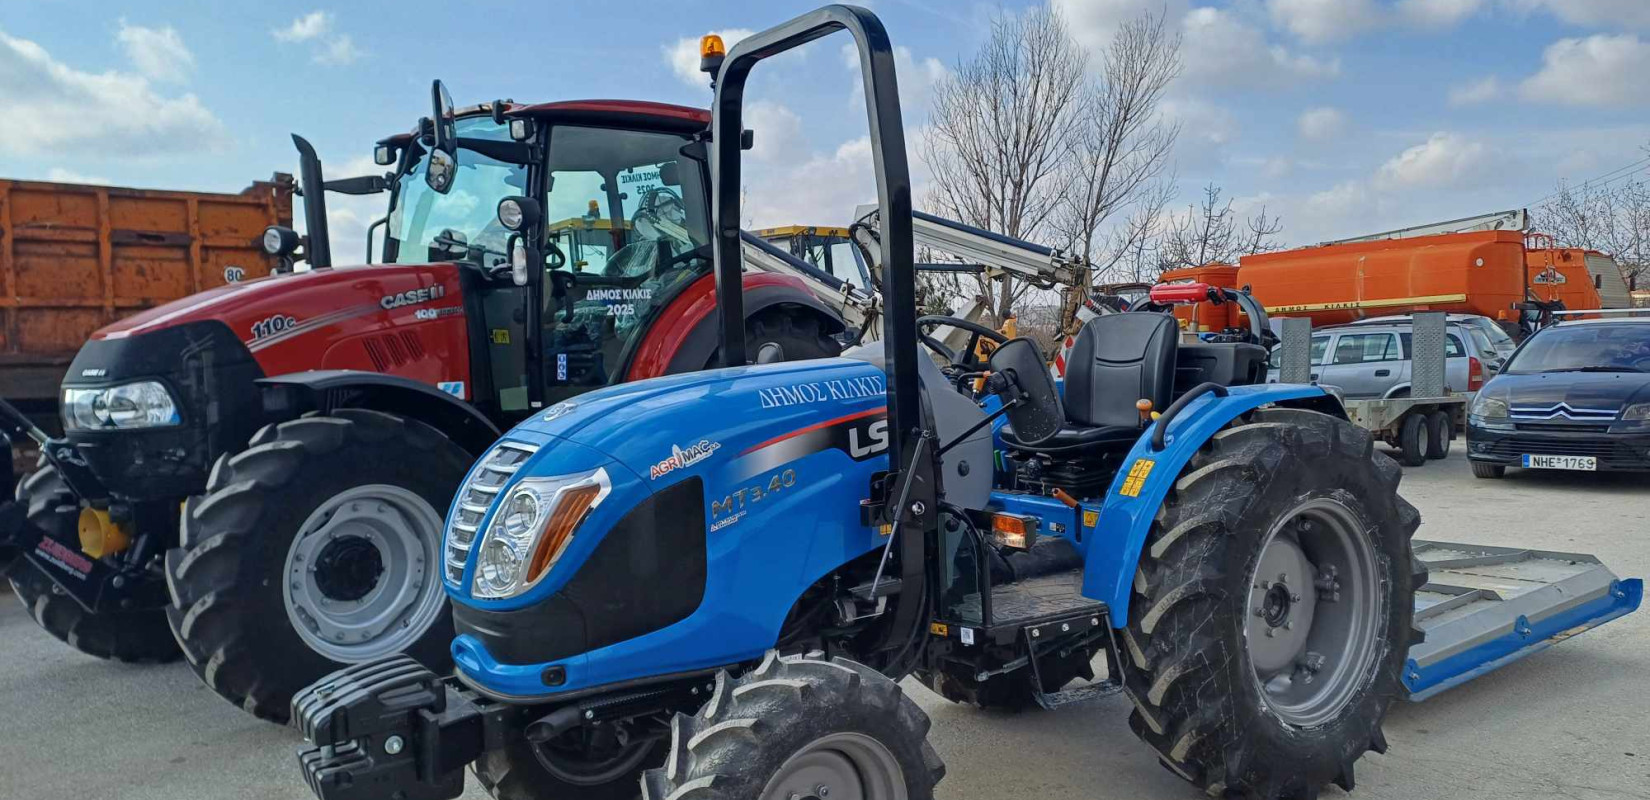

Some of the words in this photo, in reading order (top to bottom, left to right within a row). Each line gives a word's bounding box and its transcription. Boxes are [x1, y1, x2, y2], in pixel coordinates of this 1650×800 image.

[227, 269, 241, 281] 80
[380, 288, 429, 309] CASE
[586, 289, 621, 301] ΔΗΜΟΣ
[622, 288, 652, 300] ΚΙΛΚΙΣ
[606, 303, 635, 316] 2025
[1324, 302, 1360, 310] ΚΙΛΚΙΣ
[414, 308, 438, 319] 100
[759, 382, 828, 409] ΔΗΜΟΣ
[824, 375, 887, 400] ΚΙΛΚΙΣ
[848, 419, 889, 459] LS
